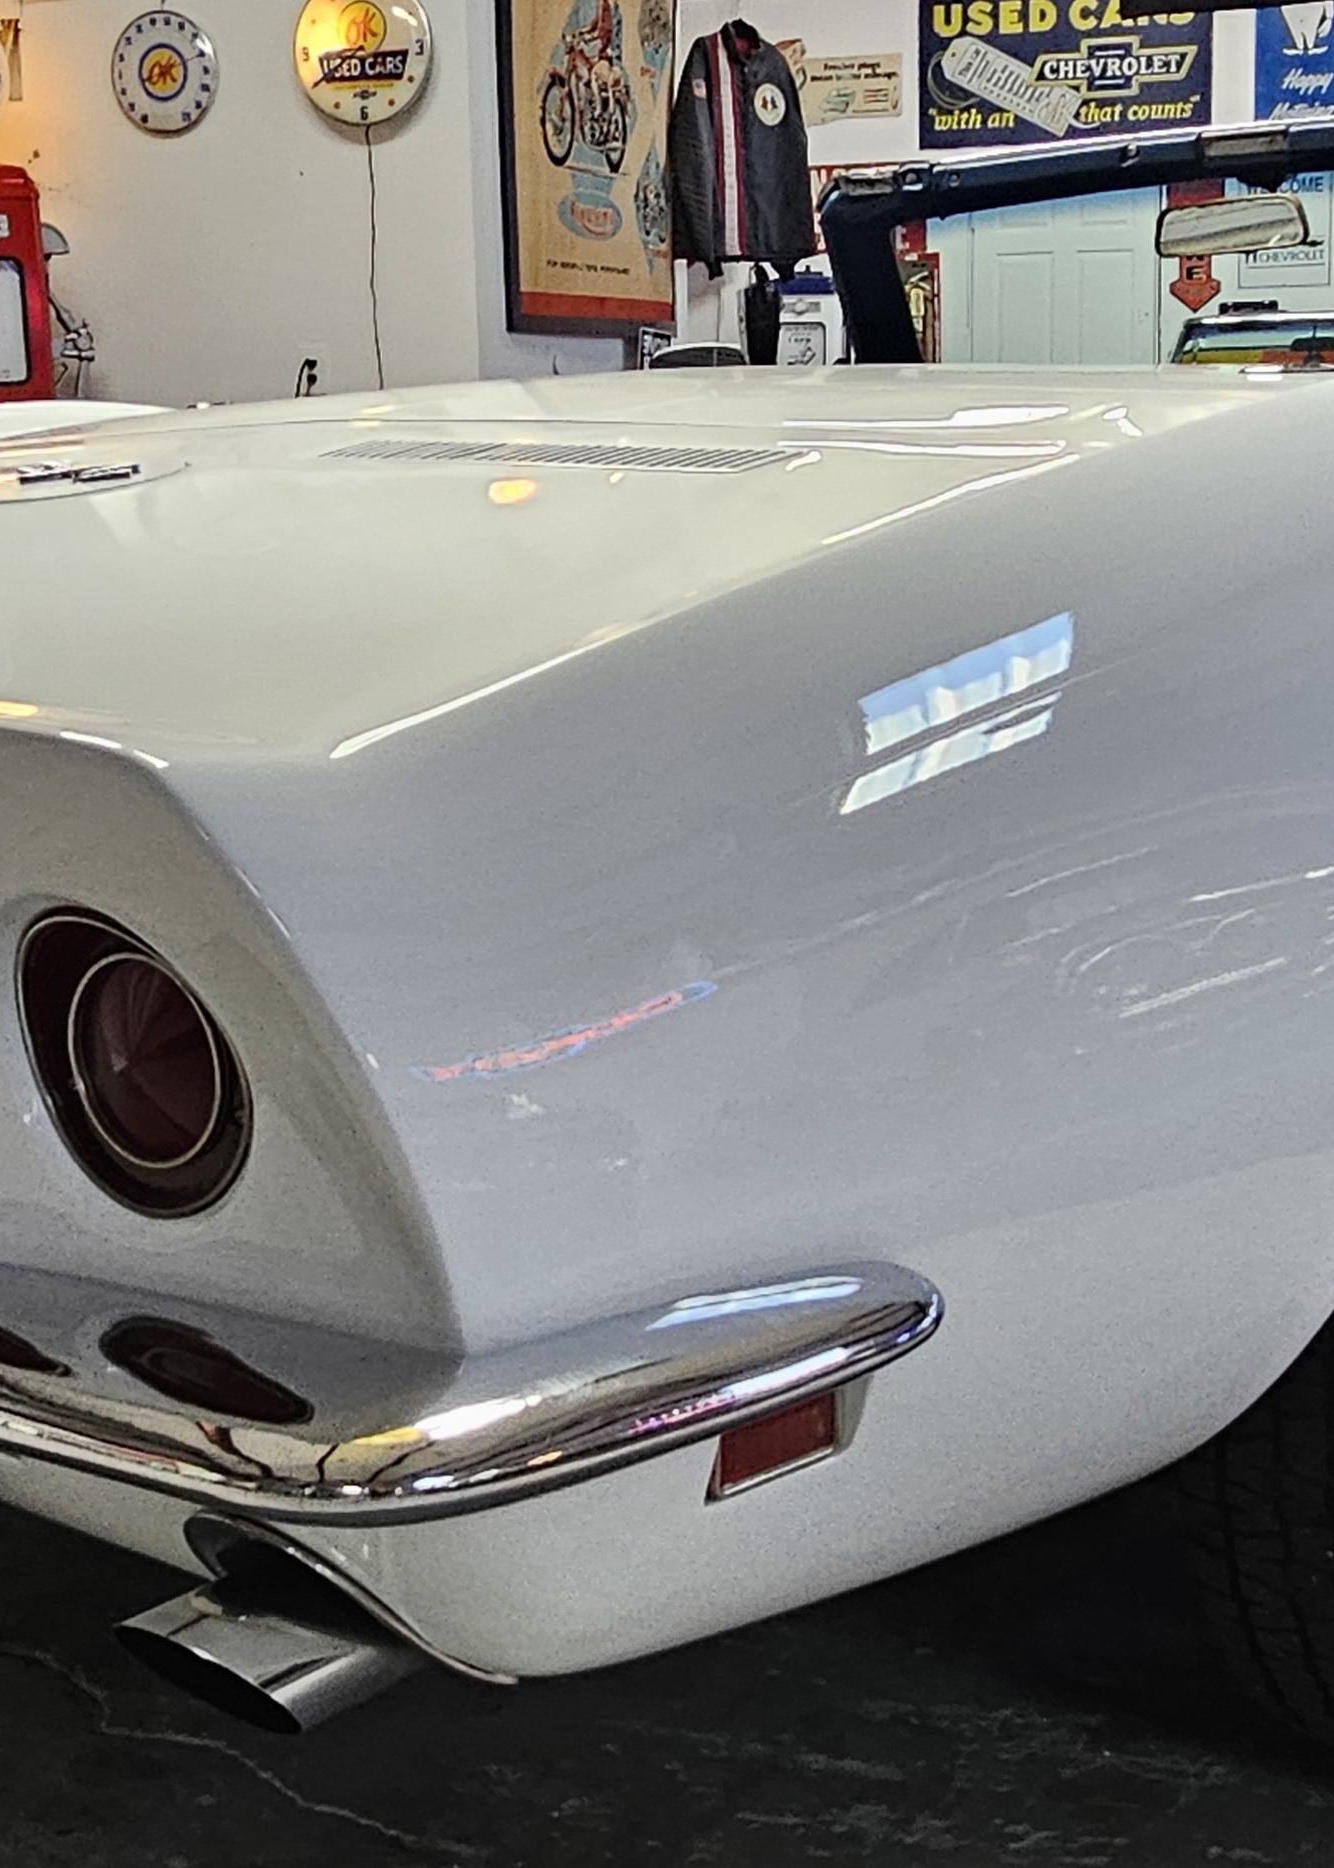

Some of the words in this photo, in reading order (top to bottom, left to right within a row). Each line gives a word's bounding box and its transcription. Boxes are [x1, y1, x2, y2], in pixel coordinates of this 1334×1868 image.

[933, 0, 1057, 38] USED
[415, 38, 425, 56] 3
[323, 57, 361, 77] USED
[365, 55, 403, 75] CARS
[1043, 54, 1180, 79] CHEVROLET
[1281, 68, 1334, 95] Happy
[360, 106, 369, 121] 6
[987, 110, 1015, 129] an
[1078, 101, 1123, 124] that
